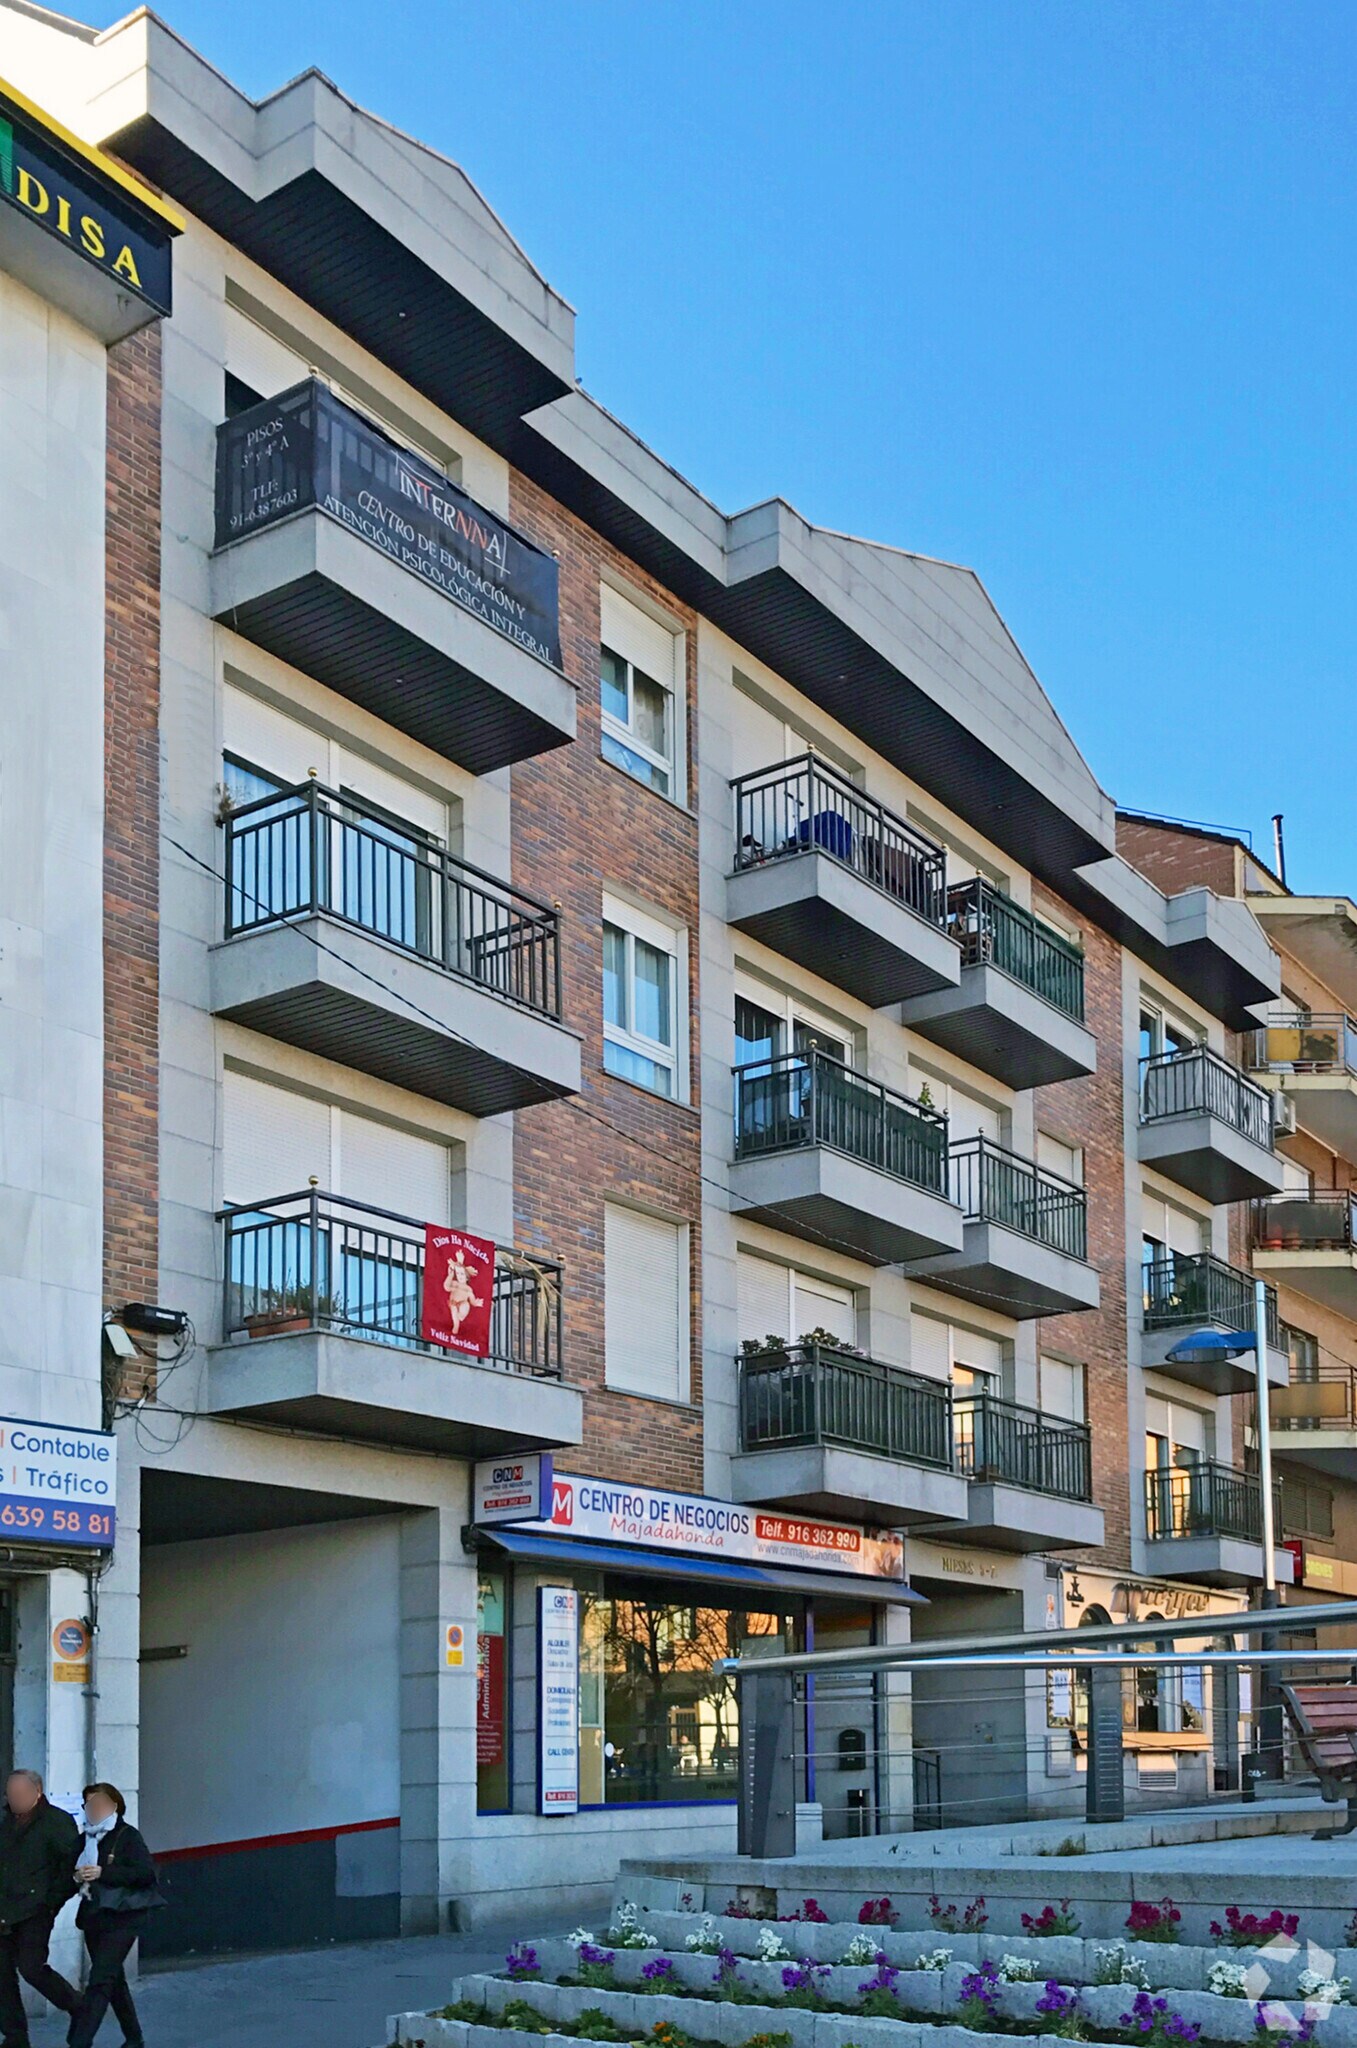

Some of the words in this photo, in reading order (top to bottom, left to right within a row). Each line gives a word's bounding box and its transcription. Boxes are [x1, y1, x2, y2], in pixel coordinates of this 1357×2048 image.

[16, 166, 142, 289] DISA
[247, 417, 284, 447] PISOS
[400, 469, 502, 560] INTERNNA
[357, 490, 415, 542] CENTRO
[418, 534, 437, 559] DE
[439, 548, 515, 615] EDUCACIÓN
[324, 493, 399, 558] ATENCIÓN
[402, 546, 489, 618] PSICOLÓGICA
[491, 608, 554, 664] INTEGRAL
[10, 1431, 110, 1462] Contable
[25, 1466, 109, 1495] Tráfico
[493, 1466, 523, 1483] CNM
[1, 1504, 45, 1528] 639
[52, 1509, 81, 1532] 58
[88, 1513, 110, 1535] 81
[579, 1487, 644, 1518] CENTRO
[649, 1499, 670, 1522] DE
[674, 1503, 750, 1535] NEGOCIOS
[611, 1517, 725, 1547] Majadahonda
[760, 1519, 784, 1538] Telf.
[788, 1524, 810, 1542] 916
[812, 1528, 834, 1545] 362
[836, 1531, 857, 1550] 990
[482, 1636, 490, 1719] Administrativa
